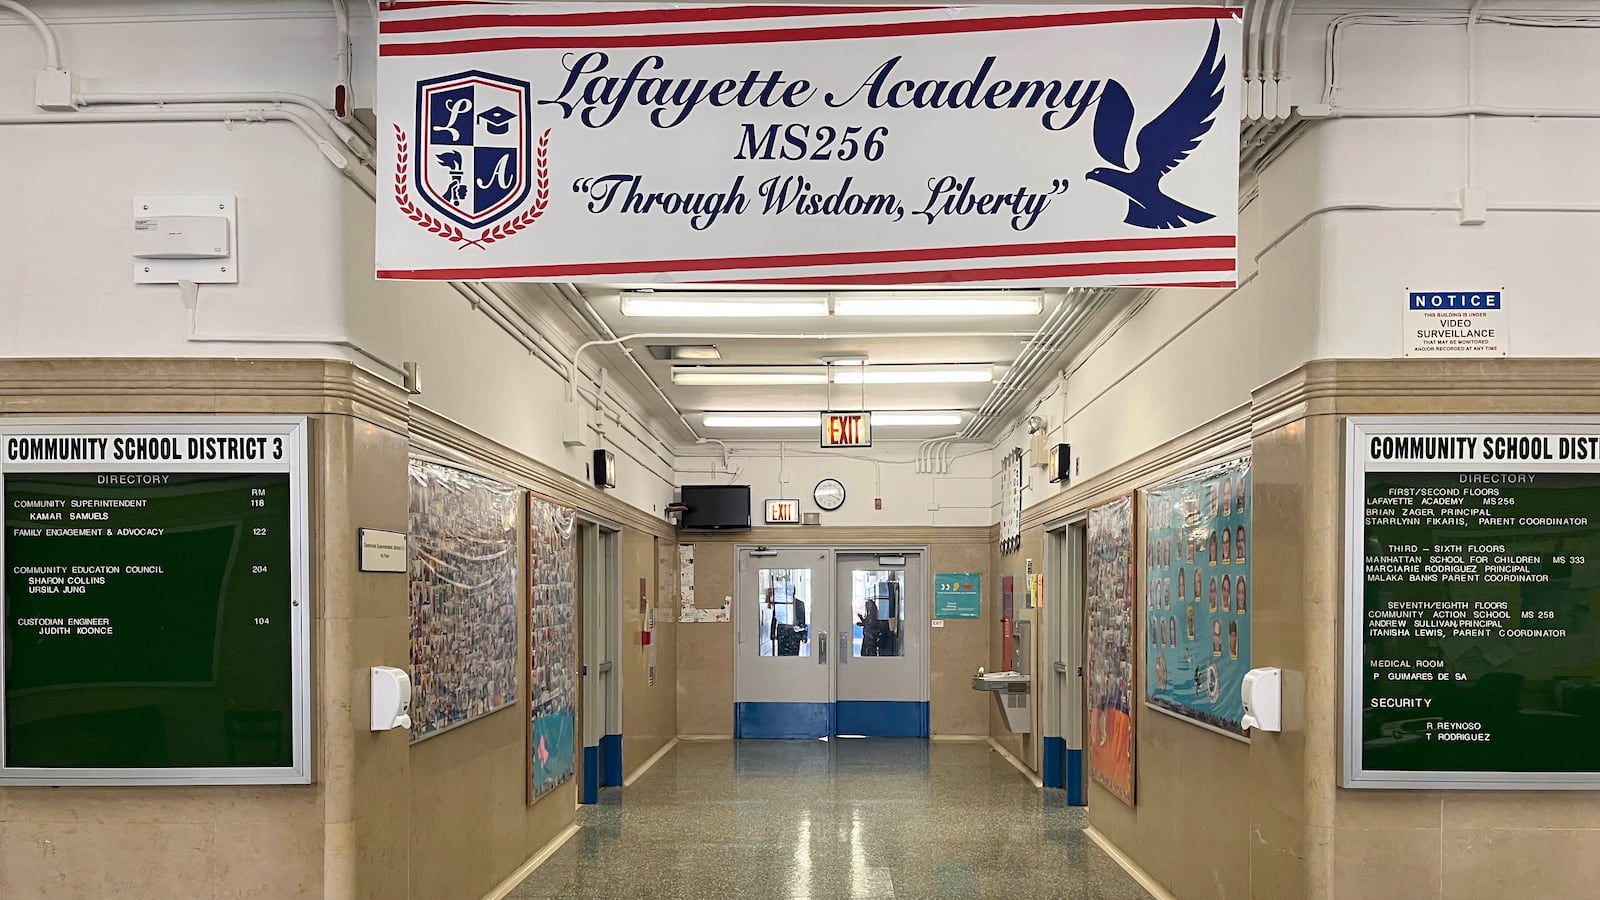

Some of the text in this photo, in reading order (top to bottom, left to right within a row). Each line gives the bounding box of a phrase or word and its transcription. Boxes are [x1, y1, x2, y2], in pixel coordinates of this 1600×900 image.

[538, 52, 1102, 130] Lafayette Academy
[734, 123, 889, 161] MS256
[573, 174, 1069, 231] “Through Wisdom, Liberty”
[1416, 296, 1495, 306] NOTICE
[831, 416, 861, 444] EXIT
[8, 438, 282, 460] COMMUNITY SCHOOL DISTRICT 3
[1371, 437, 1600, 459] COMMUNITY SCHOOL DIST
[98, 475, 169, 484] DIRECTORY
[1459, 474, 1535, 484] DIRECTORY
[1389, 488, 1499, 496] FIRST/SECOND FLOORS
[772, 504, 791, 520] EXIT
[1427, 518, 1467, 526] FIKARIS,
[117, 528, 164, 536] ADVOCACY
[1553, 556, 1566, 564] MS
[1570, 556, 1585, 564] 333
[1442, 574, 1480, 582] PARENT
[1415, 629, 1446, 638] LEWIS,
[1371, 698, 1431, 707] SECURITY
[1437, 722, 1481, 730] REYNOSO
[1438, 733, 1490, 741] RODRIGUEZ
